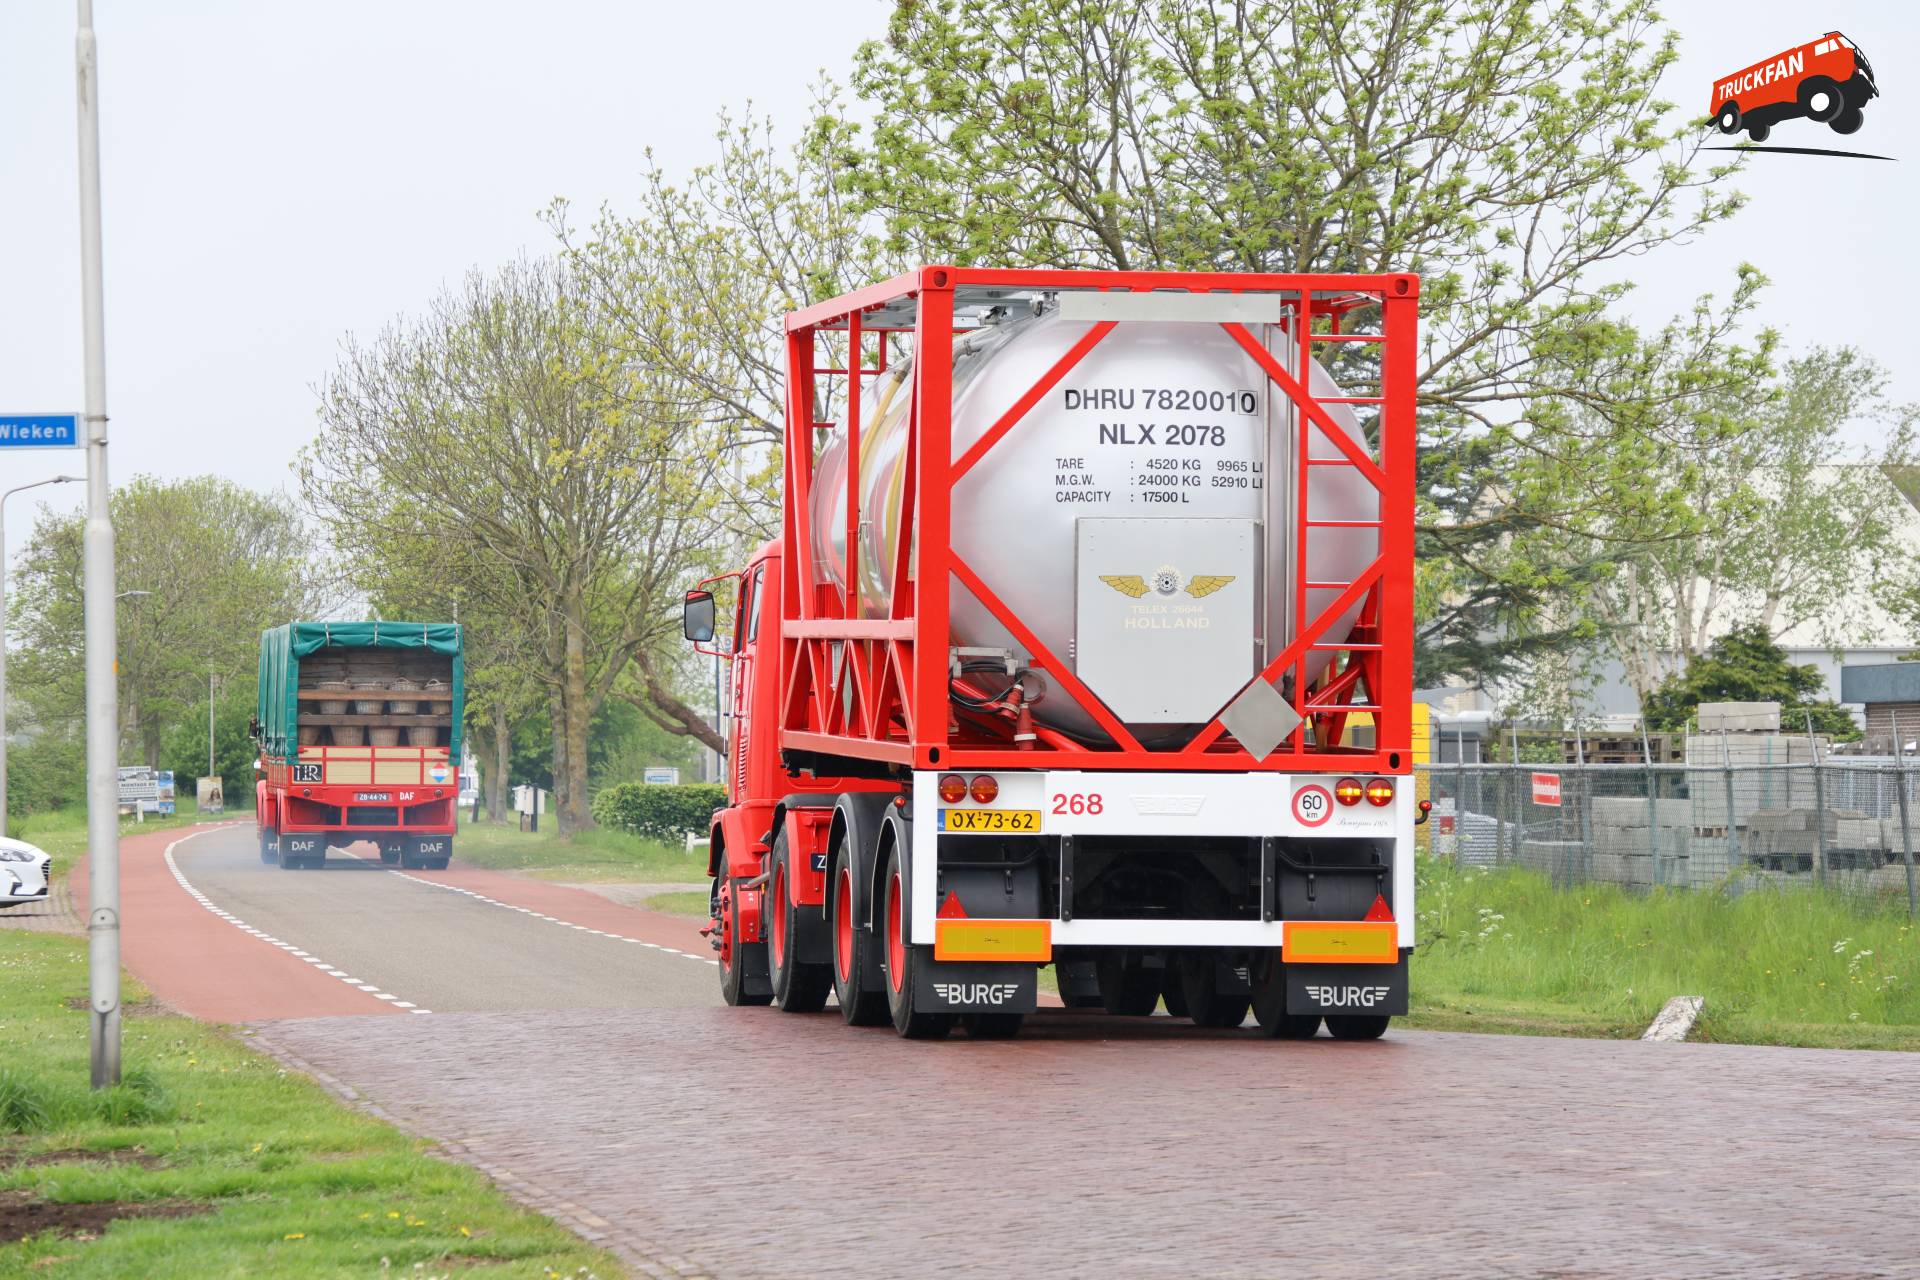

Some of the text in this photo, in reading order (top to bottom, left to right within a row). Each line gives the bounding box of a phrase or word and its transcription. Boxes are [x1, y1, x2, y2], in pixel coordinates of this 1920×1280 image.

[1065, 389, 1135, 410] DHRU
[0, 424, 68, 439] Wieken
[1100, 424, 1226, 446] NLX 2078
[1056, 458, 1084, 469] TARE
[1146, 459, 1178, 470] 4520
[1183, 459, 1201, 470] KG
[1217, 460, 1248, 472] 9965
[1056, 475, 1095, 485] M.G.W.
[1139, 475, 1178, 486] 24000
[1183, 476, 1201, 486] KG
[1211, 477, 1248, 488] 52910
[1056, 491, 1111, 502] CAPACITY
[1142, 492, 1178, 502] 17500
[1182, 493, 1189, 503] L
[1132, 605, 1168, 614] TELEX
[1125, 618, 1209, 629] HOLLAND
[400, 792, 414, 800] DAF
[1303, 795, 1322, 810] 60
[1052, 794, 1103, 815] 268
[291, 841, 315, 851] DAF
[420, 843, 443, 852] DAF
[948, 984, 1003, 1004] BURG
[1320, 986, 1375, 1007] BURG
